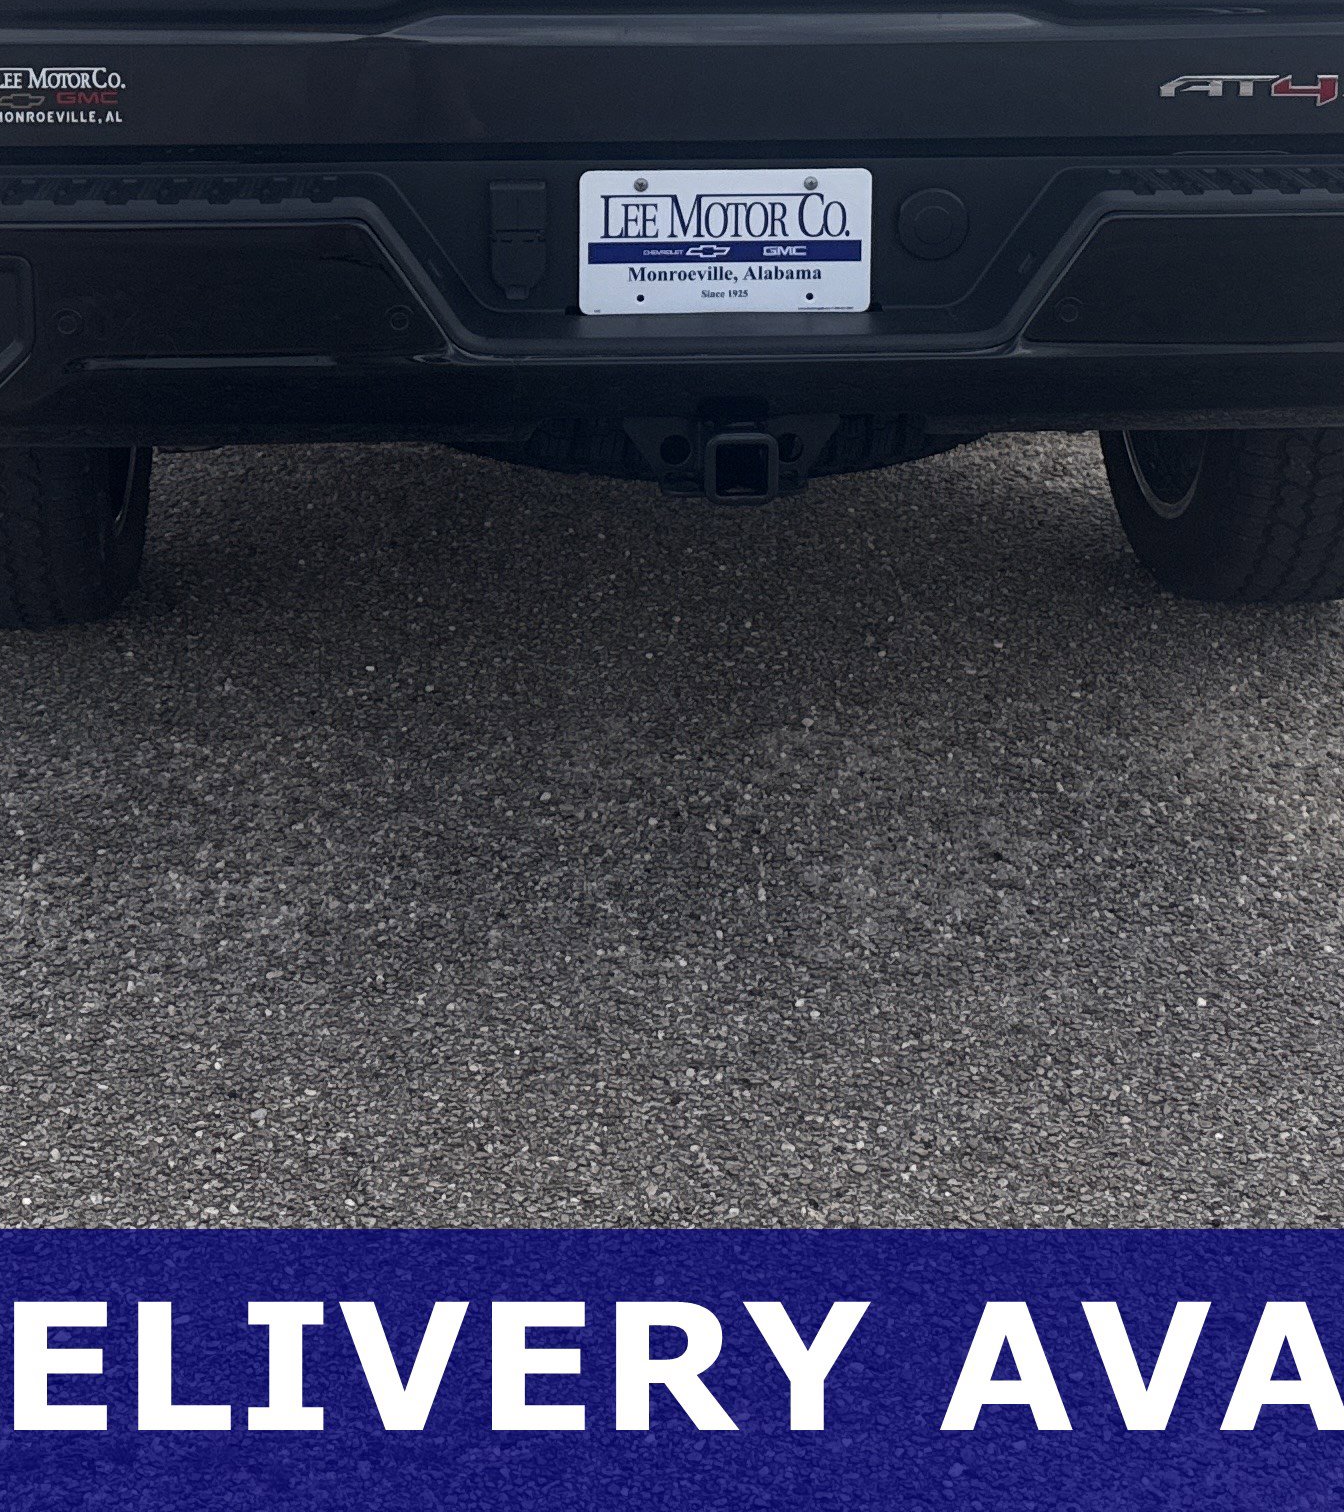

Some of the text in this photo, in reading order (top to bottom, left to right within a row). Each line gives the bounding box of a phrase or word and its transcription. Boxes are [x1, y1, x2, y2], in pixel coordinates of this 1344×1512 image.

[28, 67, 90, 89] MOTOR
[91, 67, 127, 89] CO.
[55, 91, 118, 105] GMC
[105, 110, 123, 123] AL
[600, 192, 851, 239] LEE MOTOR CO.
[762, 245, 807, 257] GMC
[627, 265, 822, 283] Monroeville, Alabama
[700, 289, 749, 299] Since 1925
